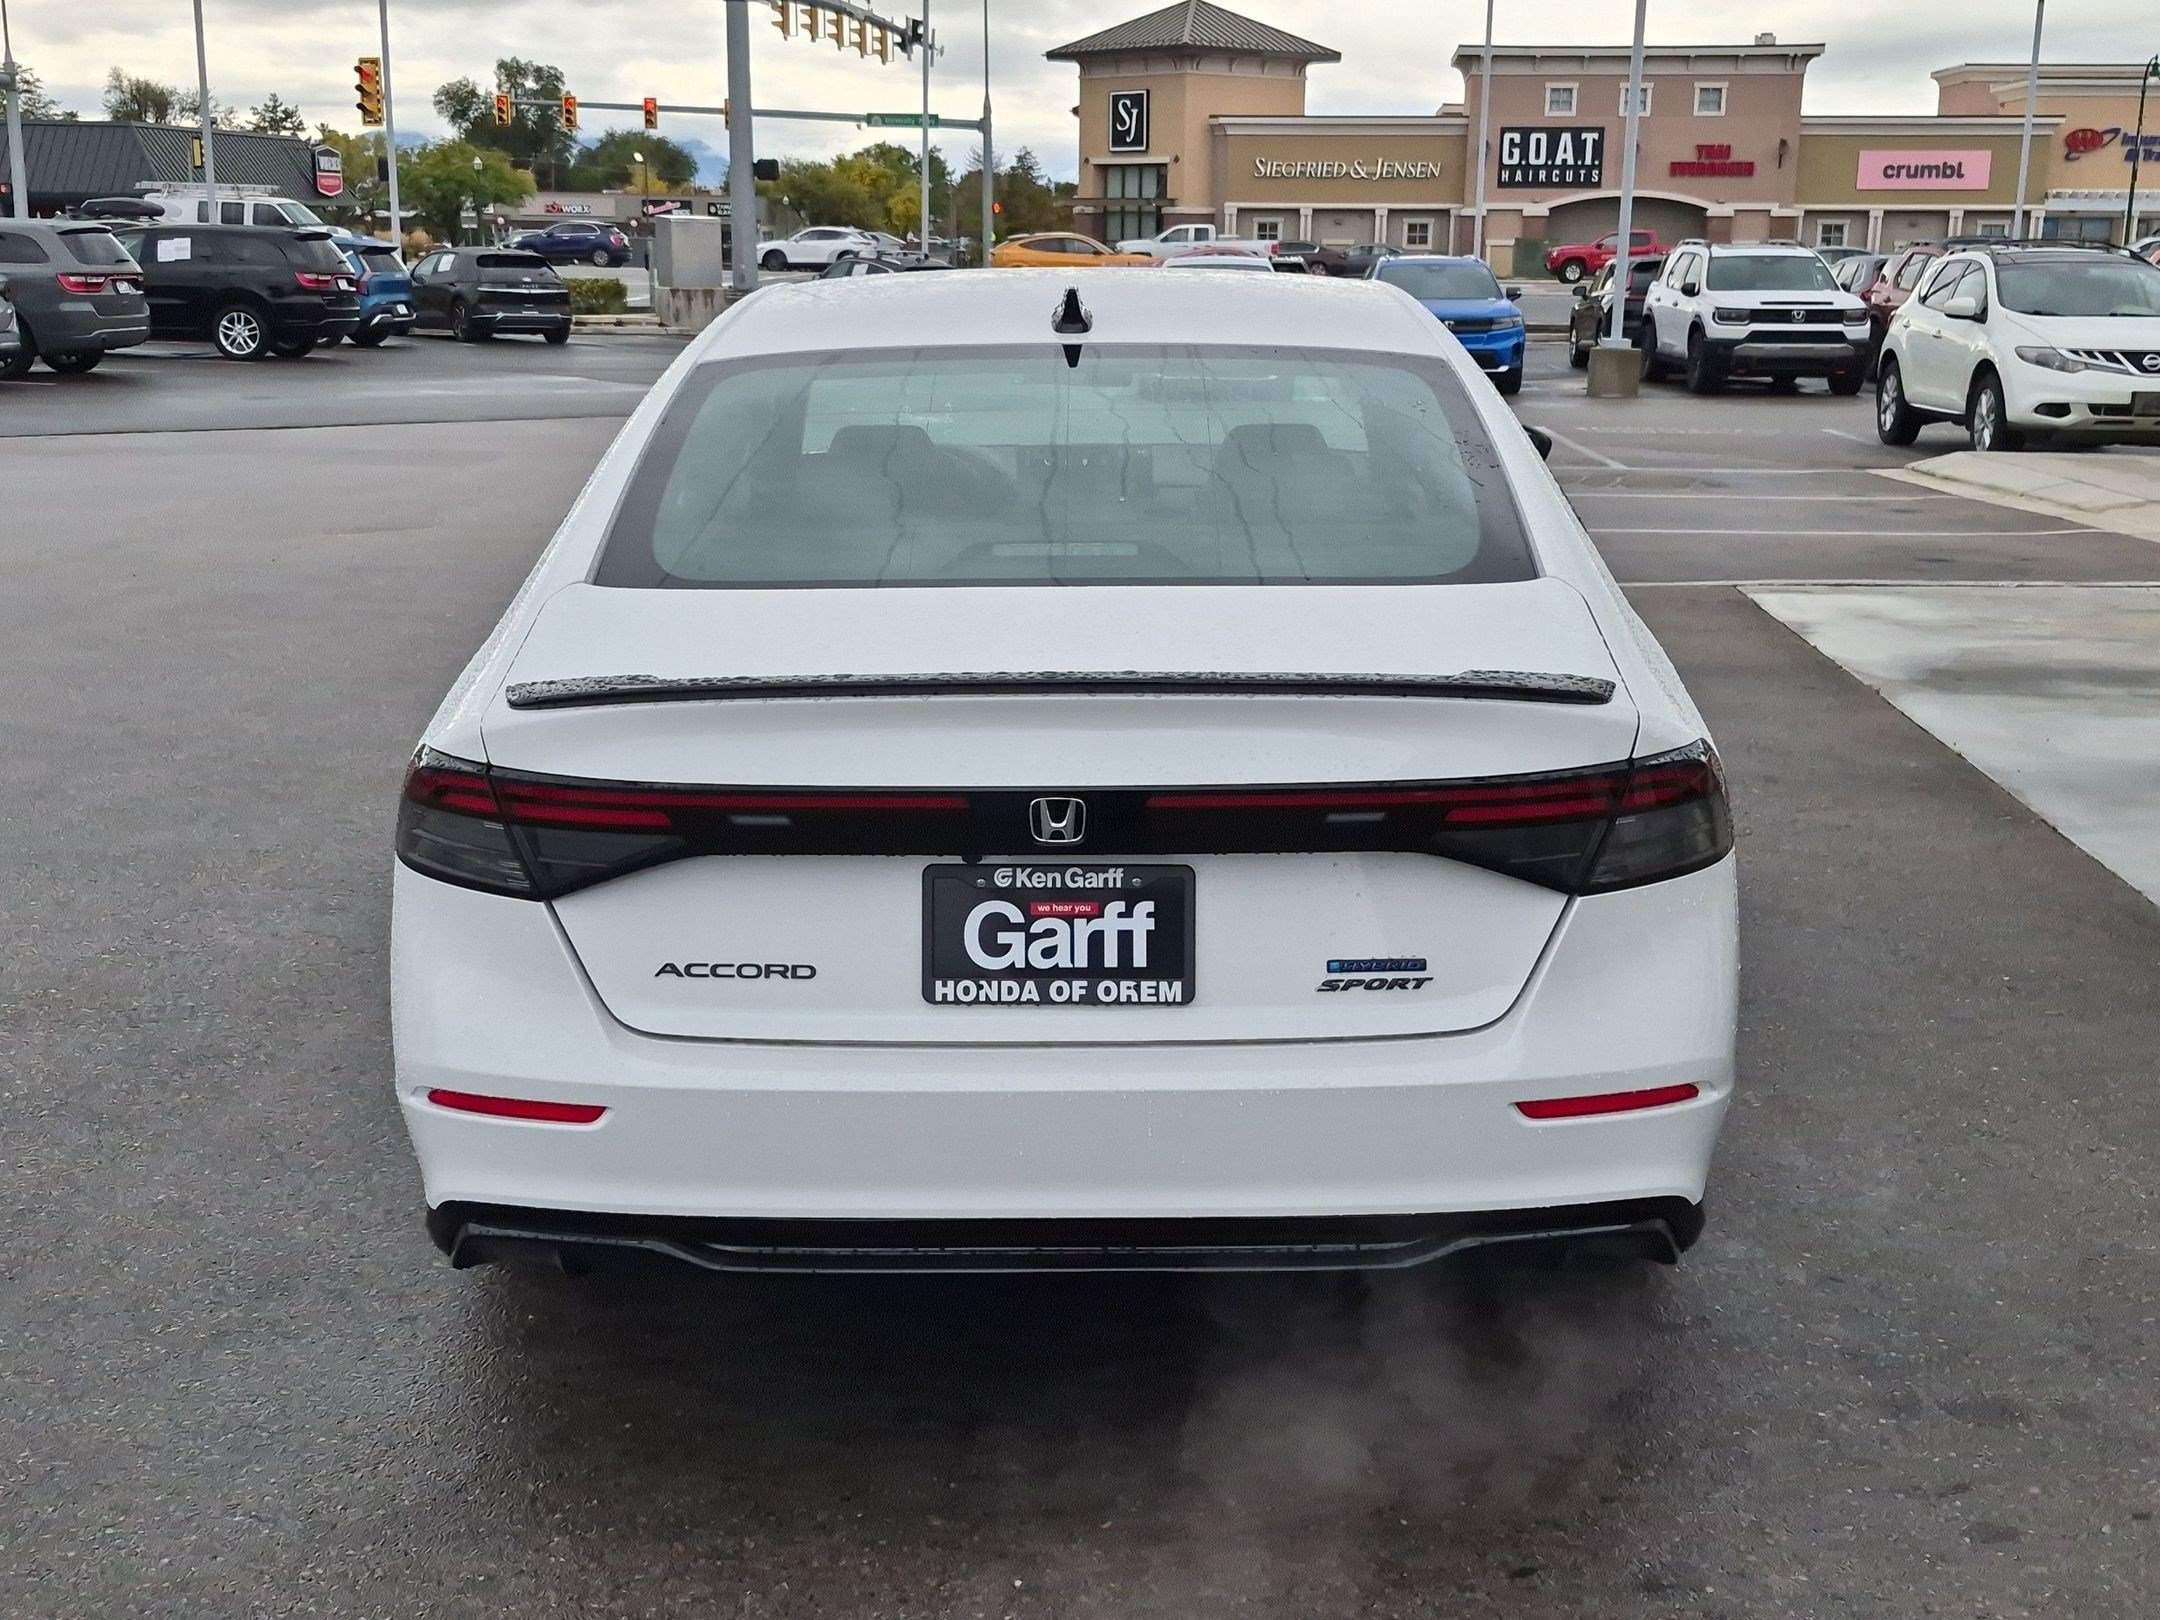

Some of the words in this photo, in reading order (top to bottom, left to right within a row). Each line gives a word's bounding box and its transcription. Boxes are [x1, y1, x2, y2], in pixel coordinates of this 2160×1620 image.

[1116, 99, 1139, 143] SJ
[1502, 132, 1600, 165] G.O.A.T.
[1254, 157, 1347, 178] SIEGFRIED
[1350, 159, 1368, 179] &
[1372, 157, 1441, 181] JENSEN
[1501, 169, 1600, 183] HAIRCUTS
[1882, 161, 1965, 179] crumbl
[1016, 867, 1062, 888] Ken
[1065, 867, 1124, 888] Garff
[1052, 903, 1073, 912] hear
[1074, 905, 1092, 914] you
[963, 900, 1156, 971] Garff
[654, 963, 817, 979] ACCORD
[1342, 960, 1421, 971] HYBRID
[935, 980, 1040, 1002] HONDA
[1050, 980, 1088, 1002] OF
[1097, 980, 1182, 1002] OREM
[1316, 977, 1434, 992] SPORT
